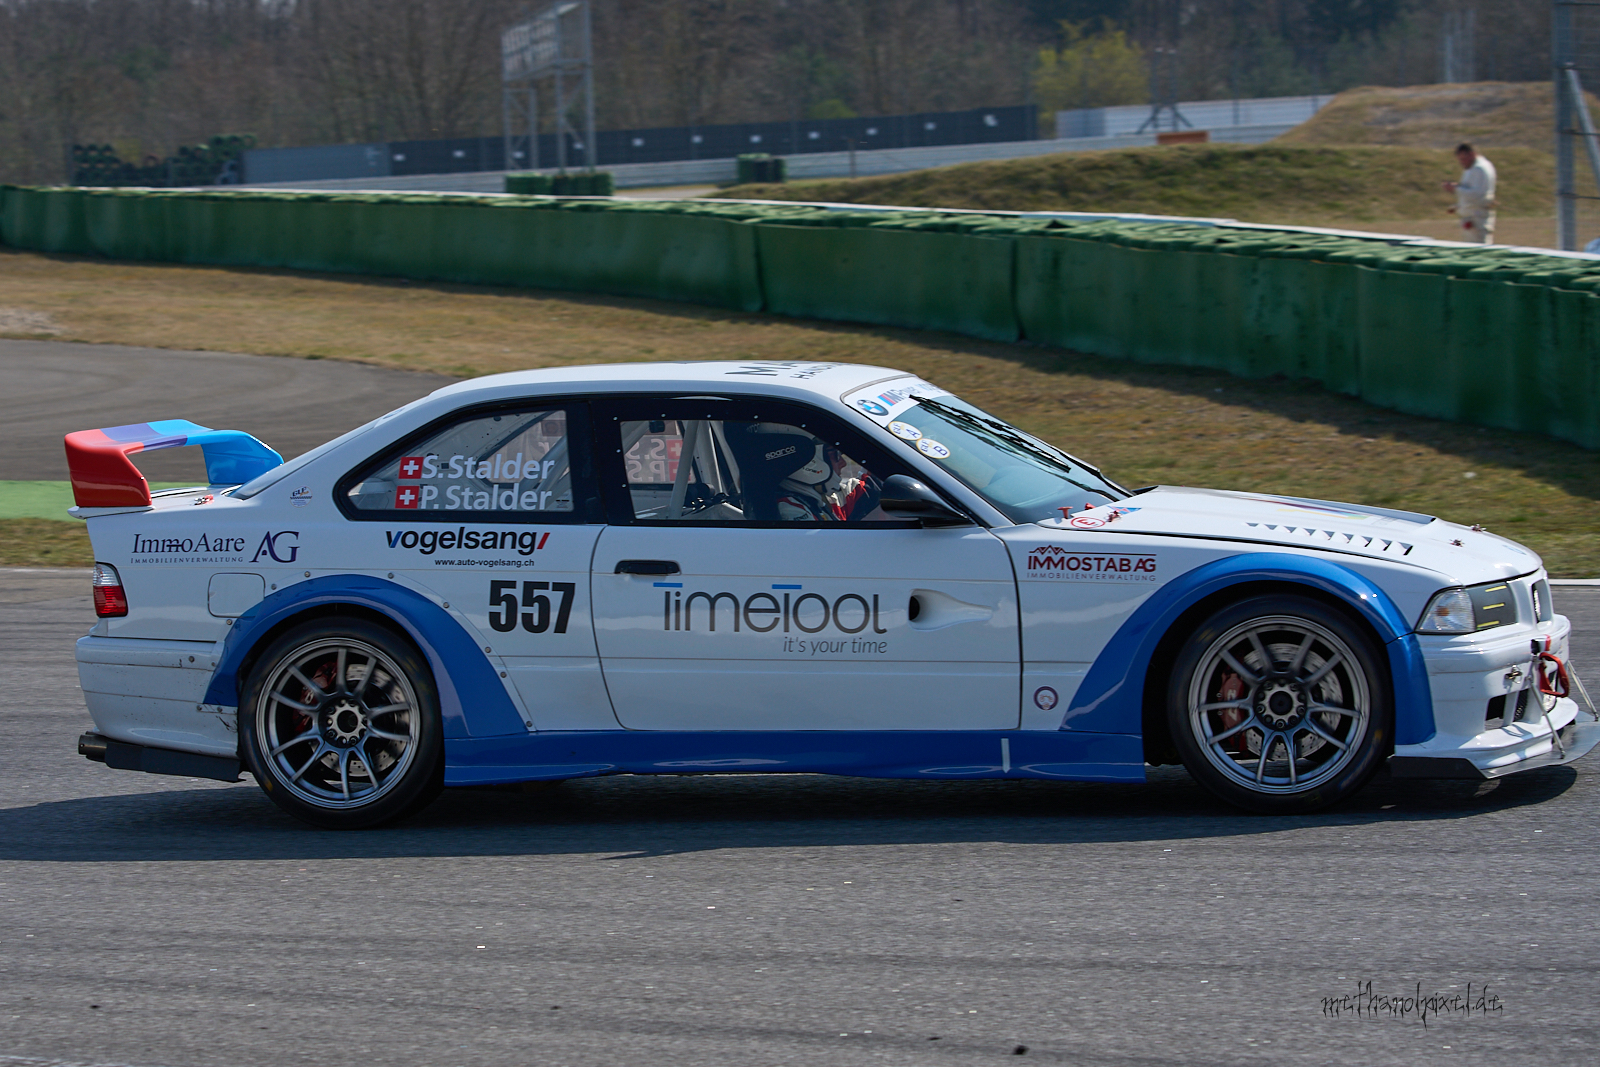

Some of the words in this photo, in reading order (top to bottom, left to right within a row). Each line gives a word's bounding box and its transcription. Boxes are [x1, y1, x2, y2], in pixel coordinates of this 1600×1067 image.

[765, 445, 797, 460] sparco
[131, 533, 245, 554] ImmoAare
[248, 531, 300, 563] AG
[434, 558, 535, 569] www.auto-vogelsang.ch
[1026, 572, 1157, 582] IMMOBILIENVERWALTUNG
[488, 580, 576, 634] 557
[783, 636, 807, 653] it's
[810, 640, 848, 656] your
[851, 637, 888, 654] time
